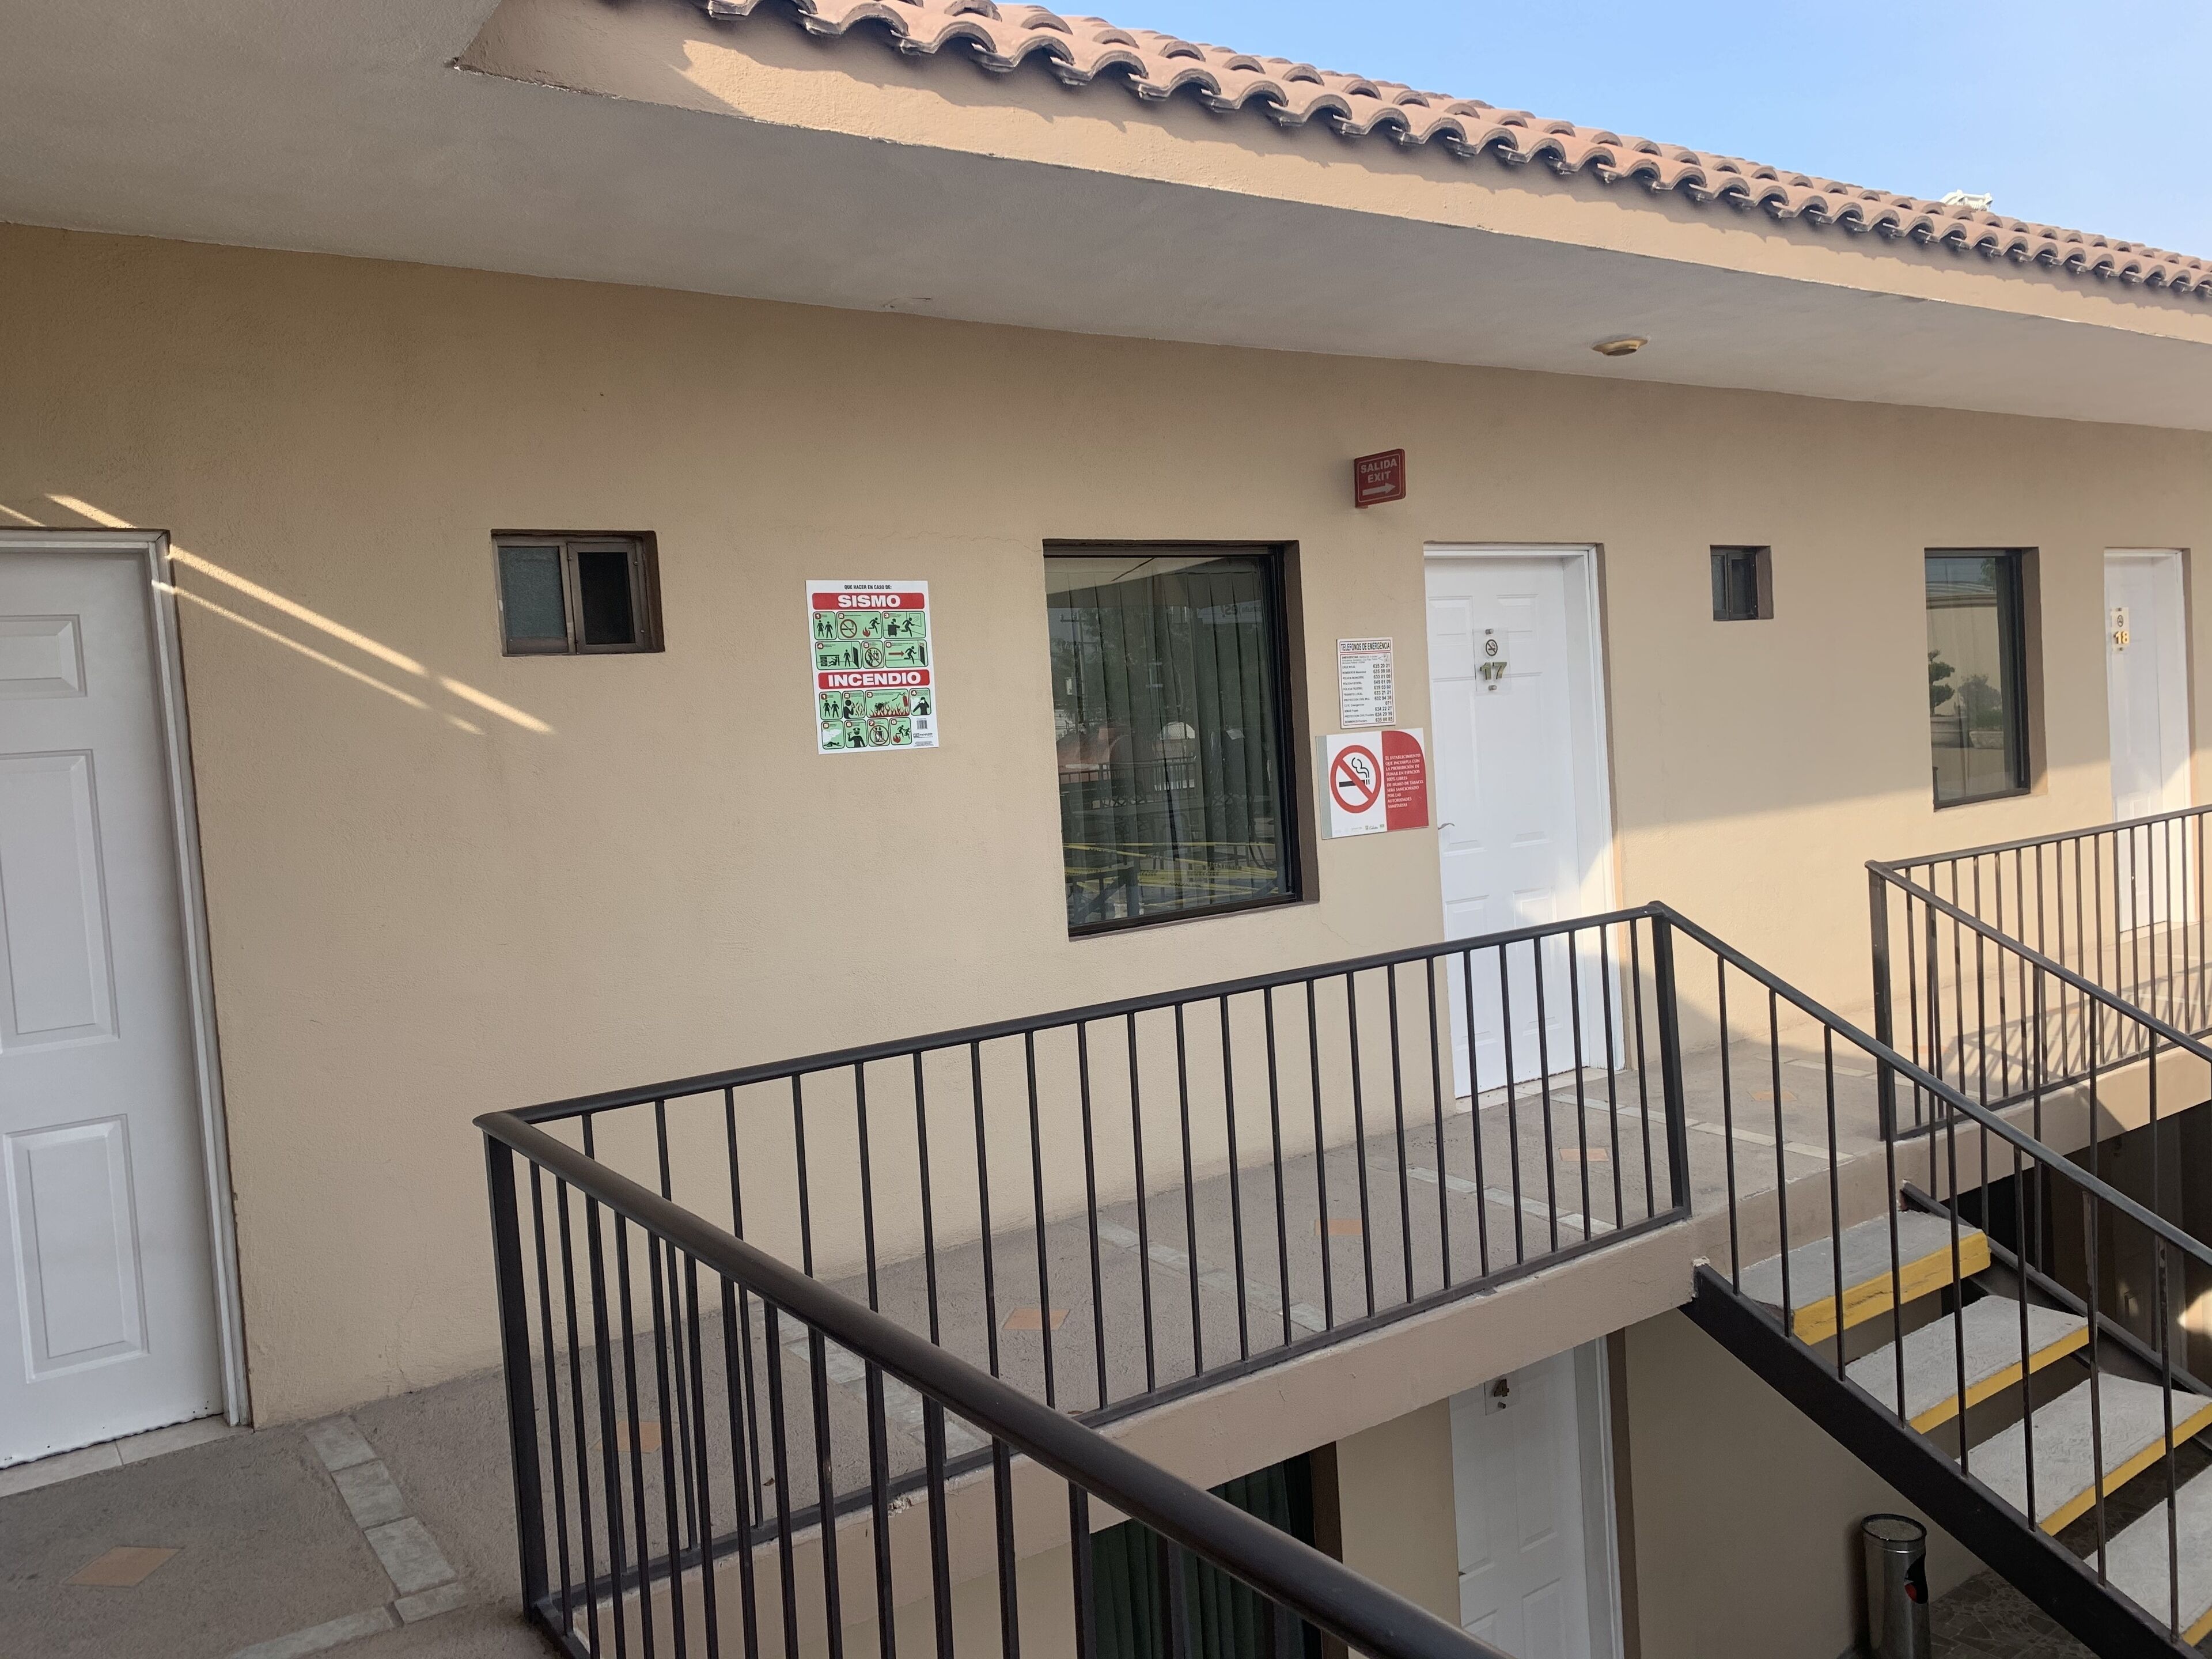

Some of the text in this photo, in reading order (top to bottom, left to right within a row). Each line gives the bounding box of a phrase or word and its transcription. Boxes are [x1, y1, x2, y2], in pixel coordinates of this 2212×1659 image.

[1361, 458, 1397, 474] SALIDA
[1368, 470, 1391, 484] EXIT
[838, 594, 901, 608] SISMO
[2113, 631, 2130, 644] 18
[1341, 643, 1361, 651] TELEFONOS
[1368, 642, 1390, 650] EMERGENCIA
[1480, 662, 1507, 680] 17
[828, 672, 921, 687] INCENDIO
[1494, 1378, 1510, 1397] 4
